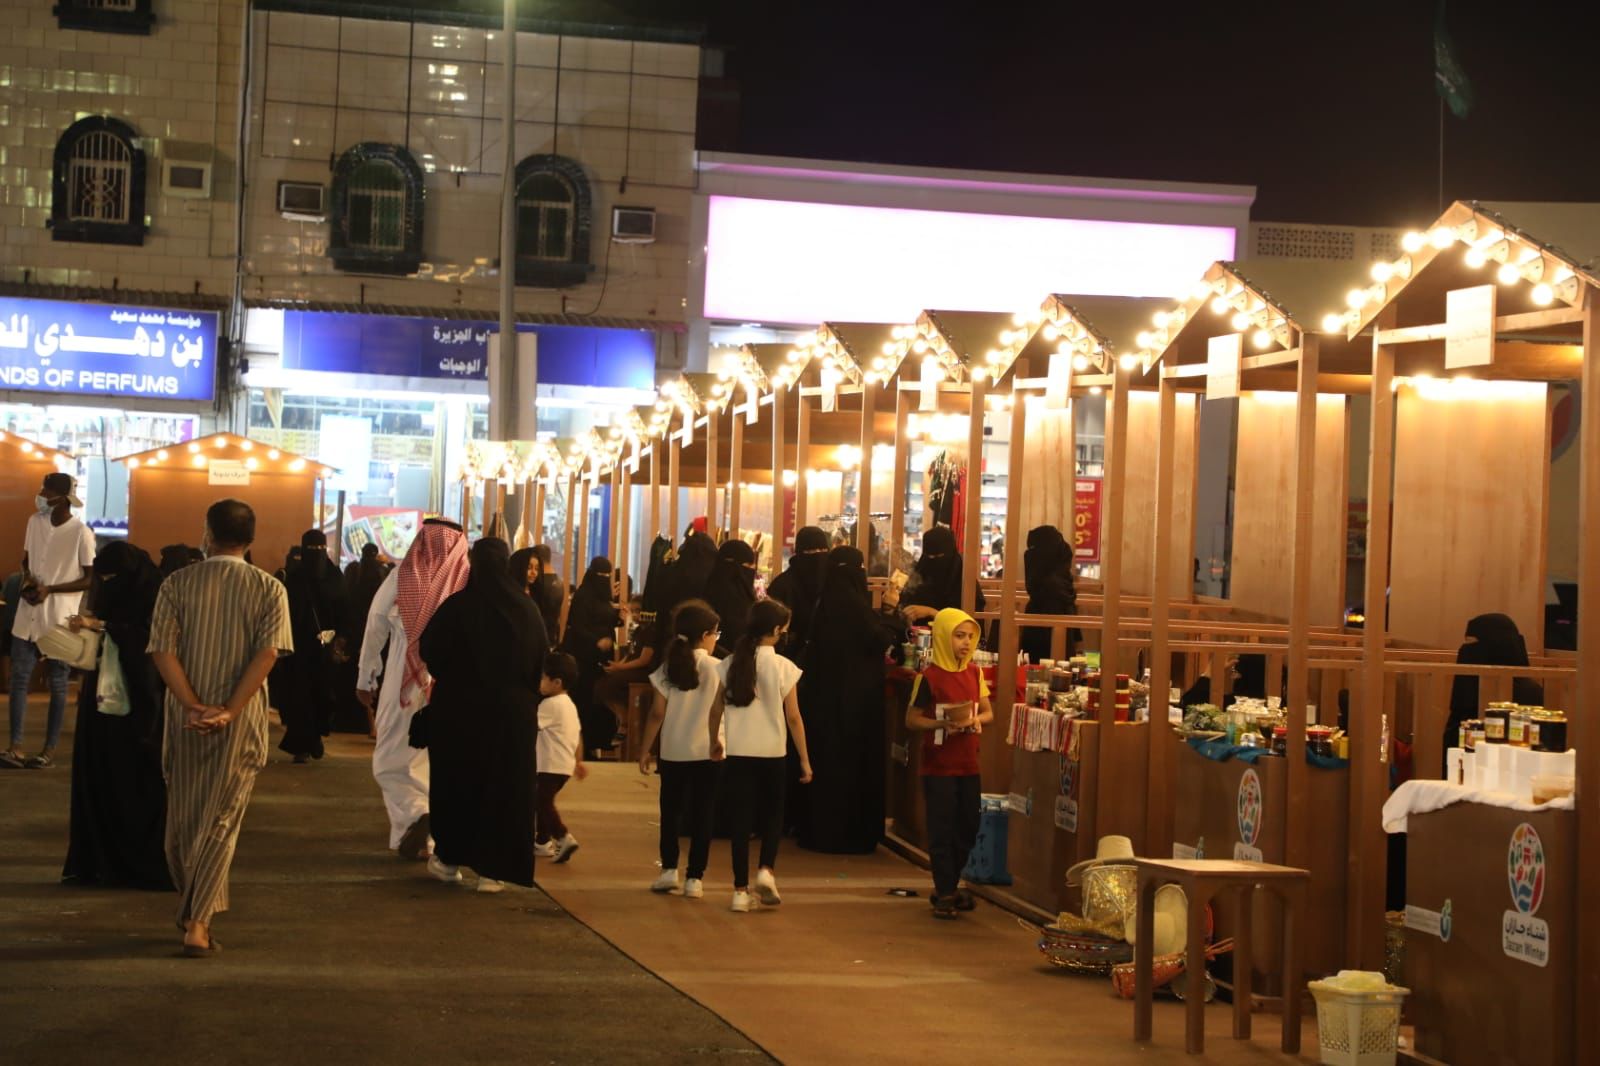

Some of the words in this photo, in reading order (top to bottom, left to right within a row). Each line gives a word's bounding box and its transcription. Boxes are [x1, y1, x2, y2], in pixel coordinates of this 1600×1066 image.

[110, 309, 137, 324] سعيد
[138, 312, 165, 325] محمد
[167, 312, 201, 329] مؤسسة
[433, 326, 472, 344] الجزيرة
[171, 333, 203, 368] بن
[439, 357, 481, 375] الوجبات
[44, 369, 74, 387] OF
[79, 371, 178, 395] PERFUMS
